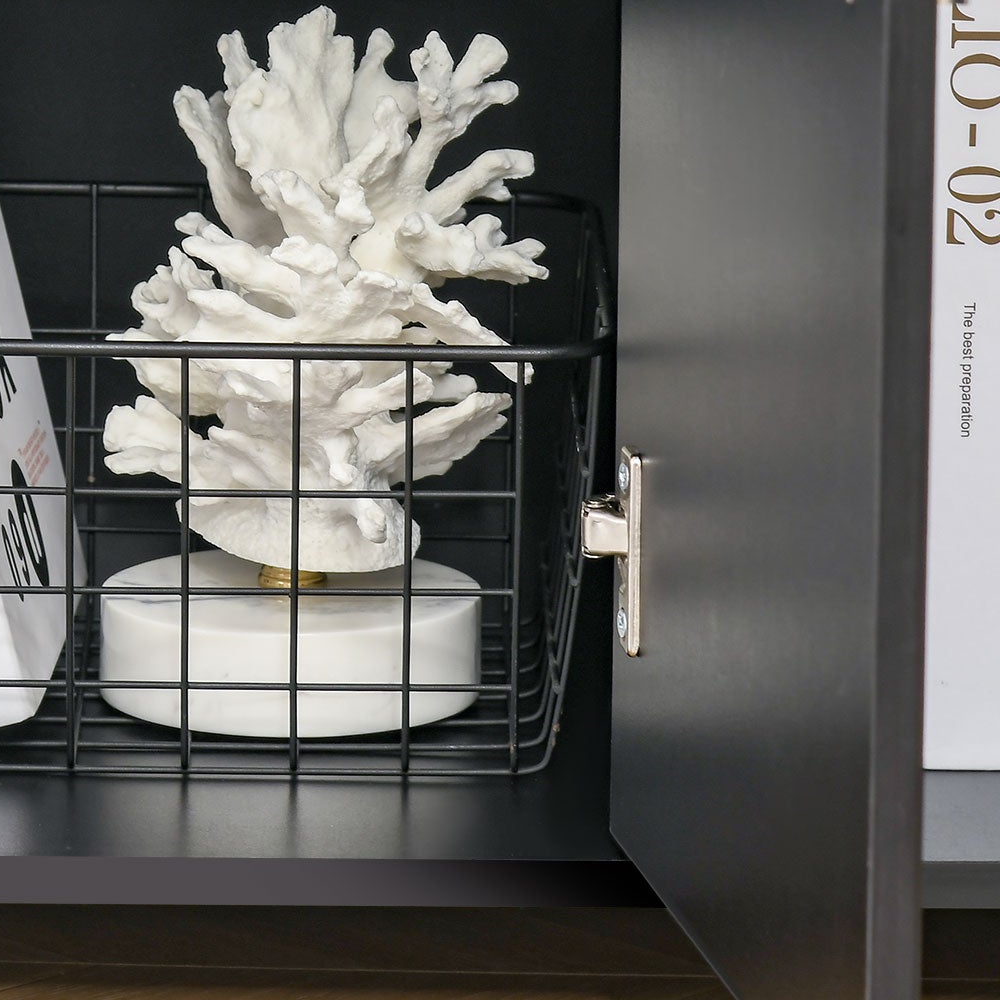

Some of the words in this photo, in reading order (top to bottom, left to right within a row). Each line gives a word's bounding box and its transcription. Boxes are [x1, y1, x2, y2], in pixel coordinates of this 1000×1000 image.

[945, 165, 1000, 246] 02
[963, 302, 977, 328] The
[962, 331, 976, 360] best
[959, 363, 974, 438] preparation
